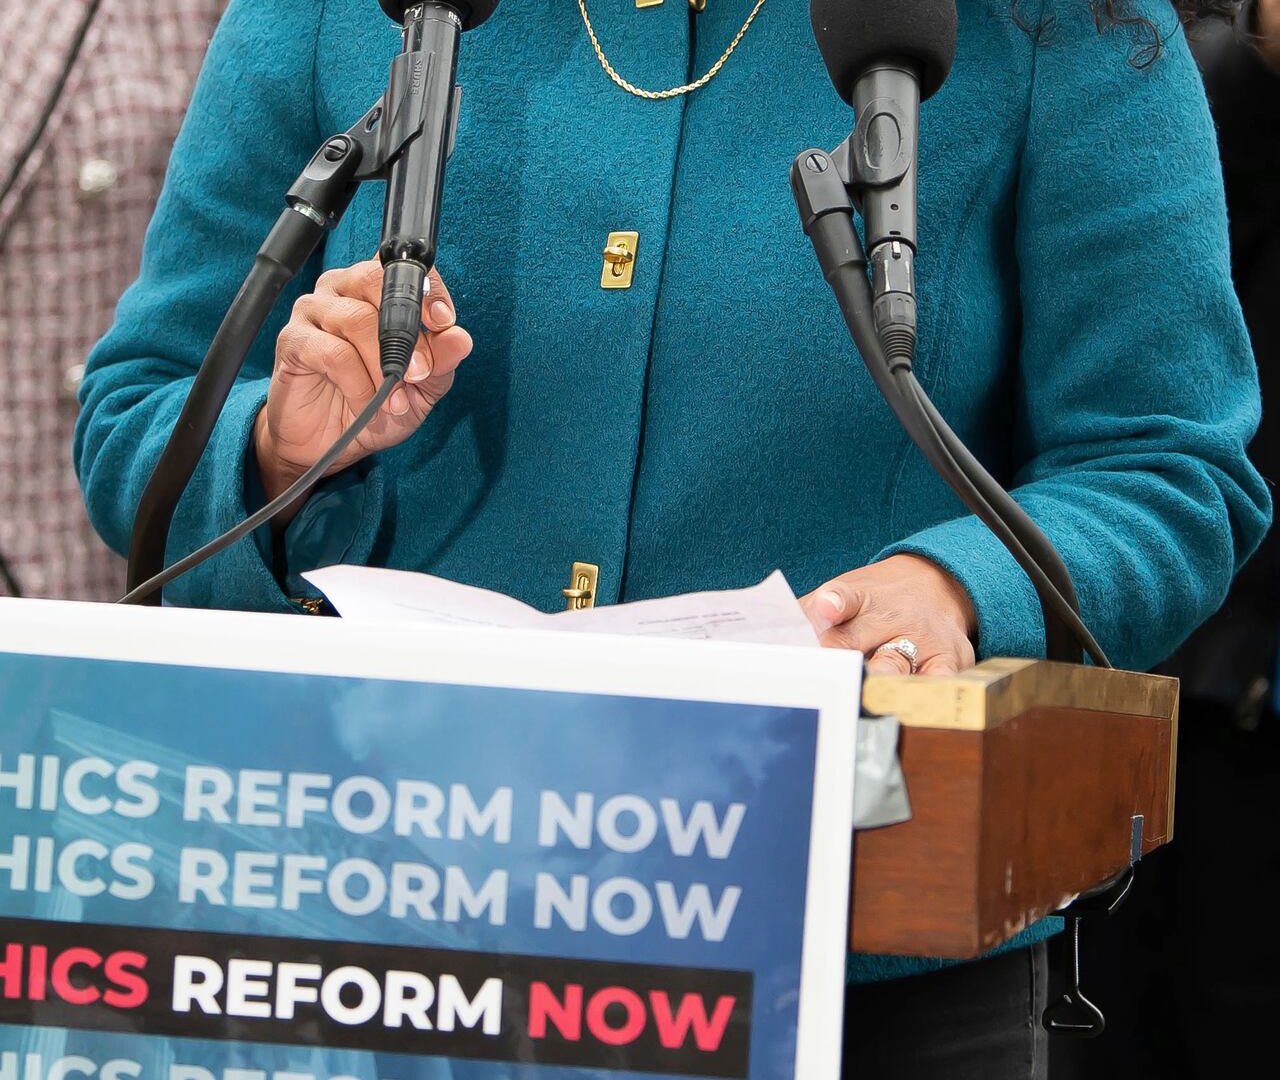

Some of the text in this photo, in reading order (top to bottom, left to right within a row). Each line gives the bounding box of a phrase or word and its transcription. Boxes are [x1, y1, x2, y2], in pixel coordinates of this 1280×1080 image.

[183, 765, 513, 844] REFORM
[537, 790, 747, 860] NOW
[179, 846, 508, 926] REFORM
[533, 872, 741, 942] NOW
[172, 955, 503, 1036] REFORM
[527, 982, 736, 1052] NOW
